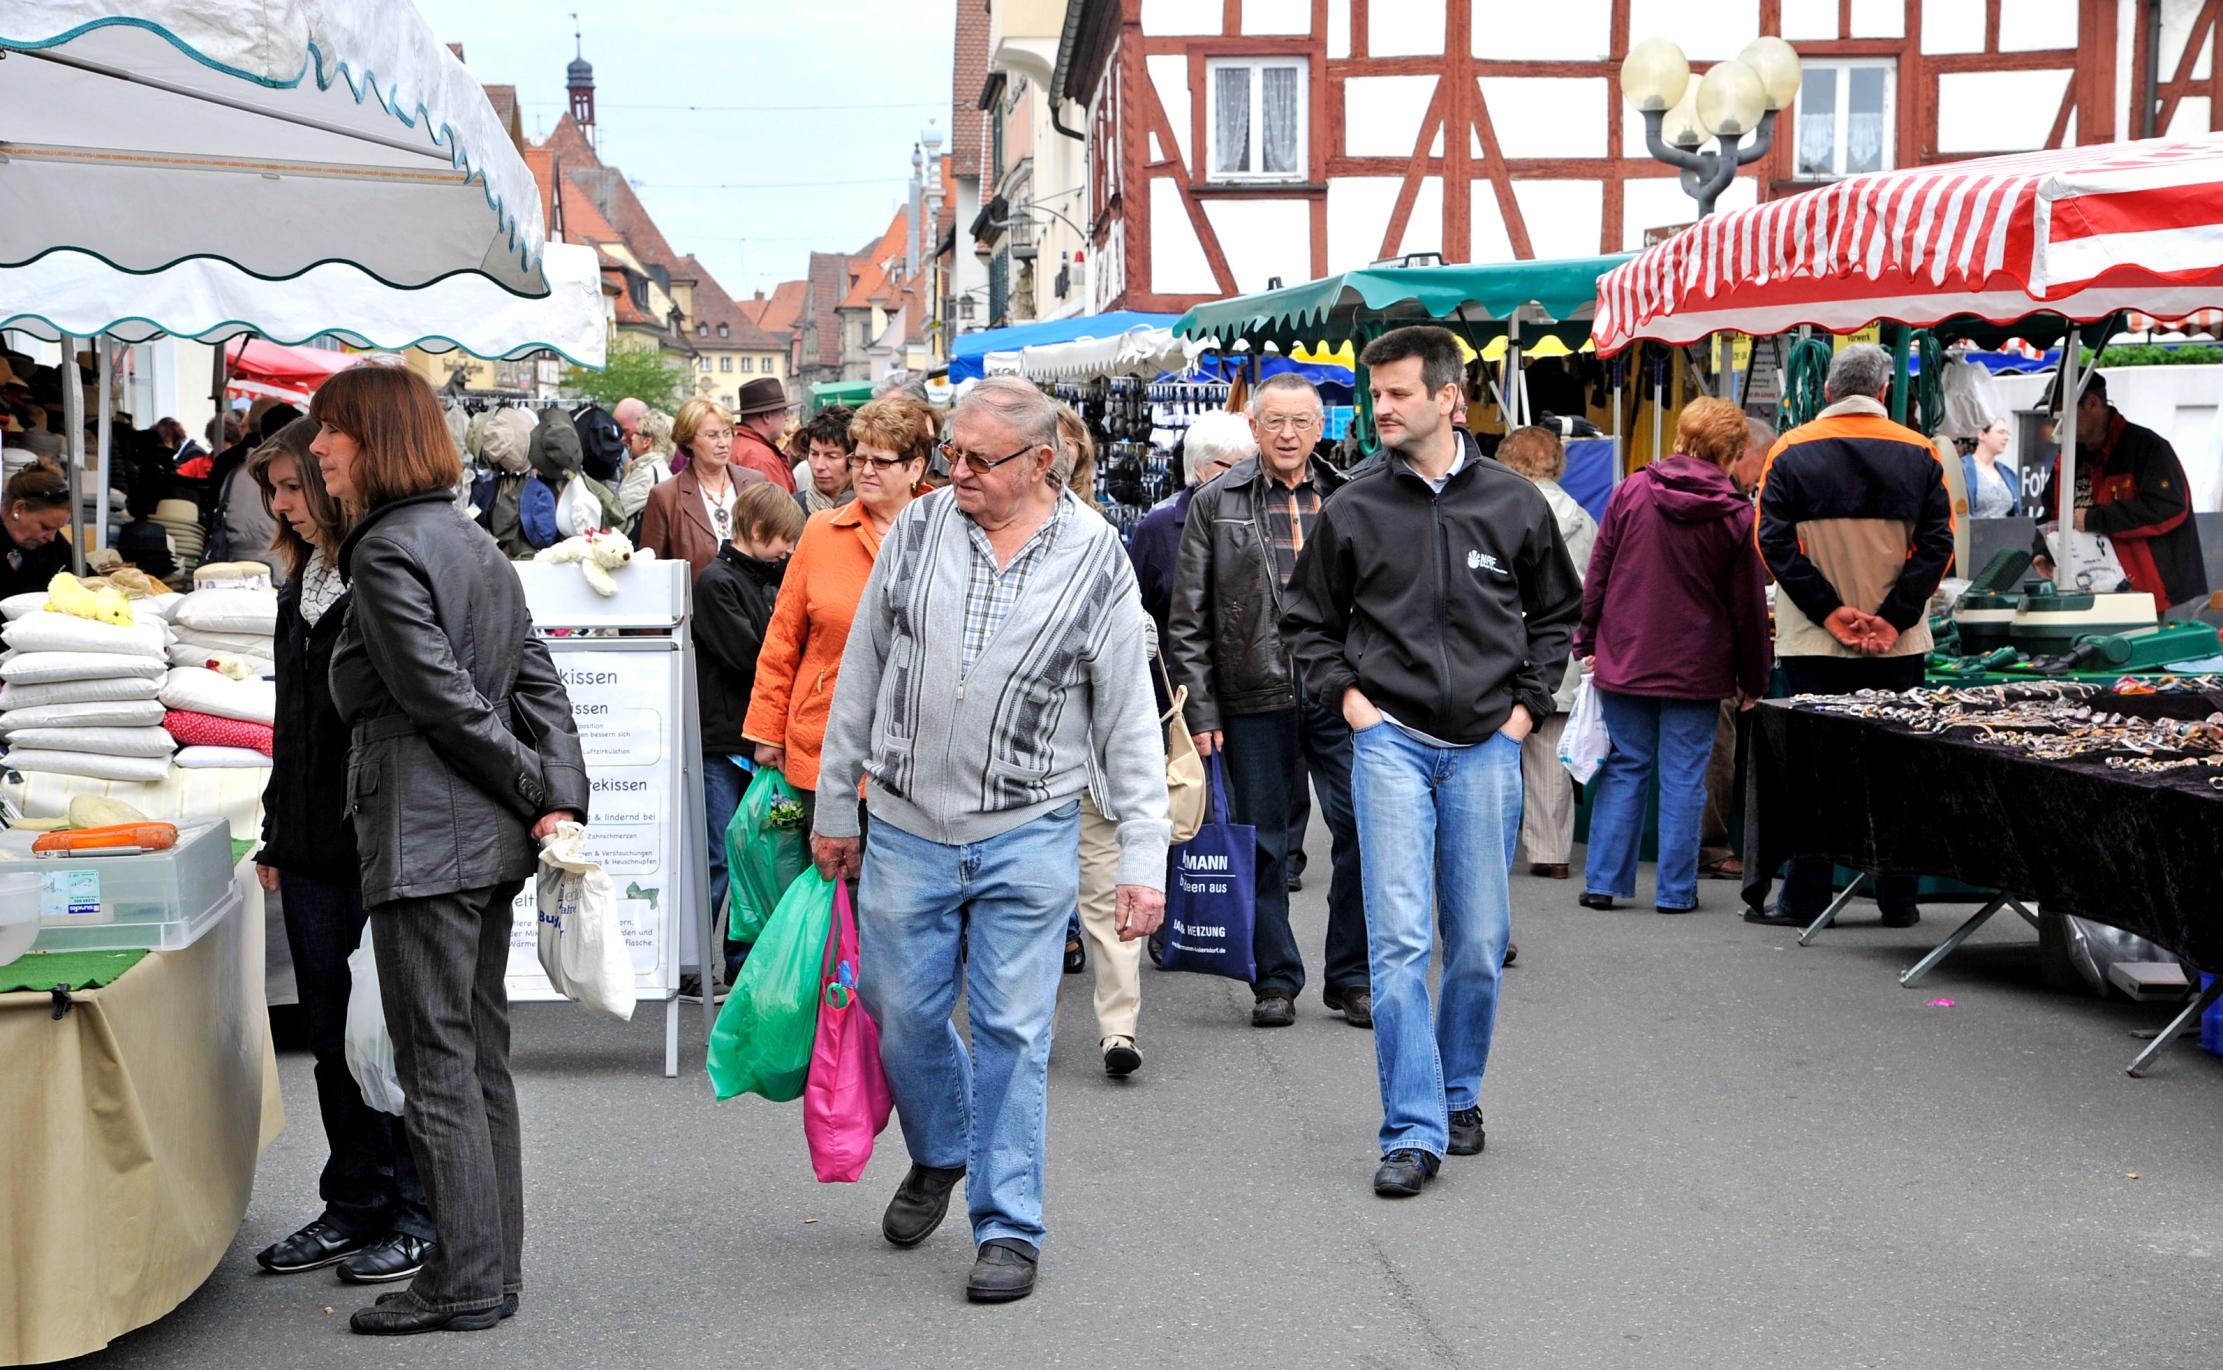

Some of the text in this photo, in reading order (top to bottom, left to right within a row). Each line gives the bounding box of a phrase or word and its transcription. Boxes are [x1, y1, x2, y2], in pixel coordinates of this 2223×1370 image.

[2021, 465, 2051, 498] Fot
[605, 813, 640, 821] lindernd
[643, 813, 656, 821] bei
[1209, 883, 1227, 893] aus
[1187, 925, 1226, 938] HEIZUNG
